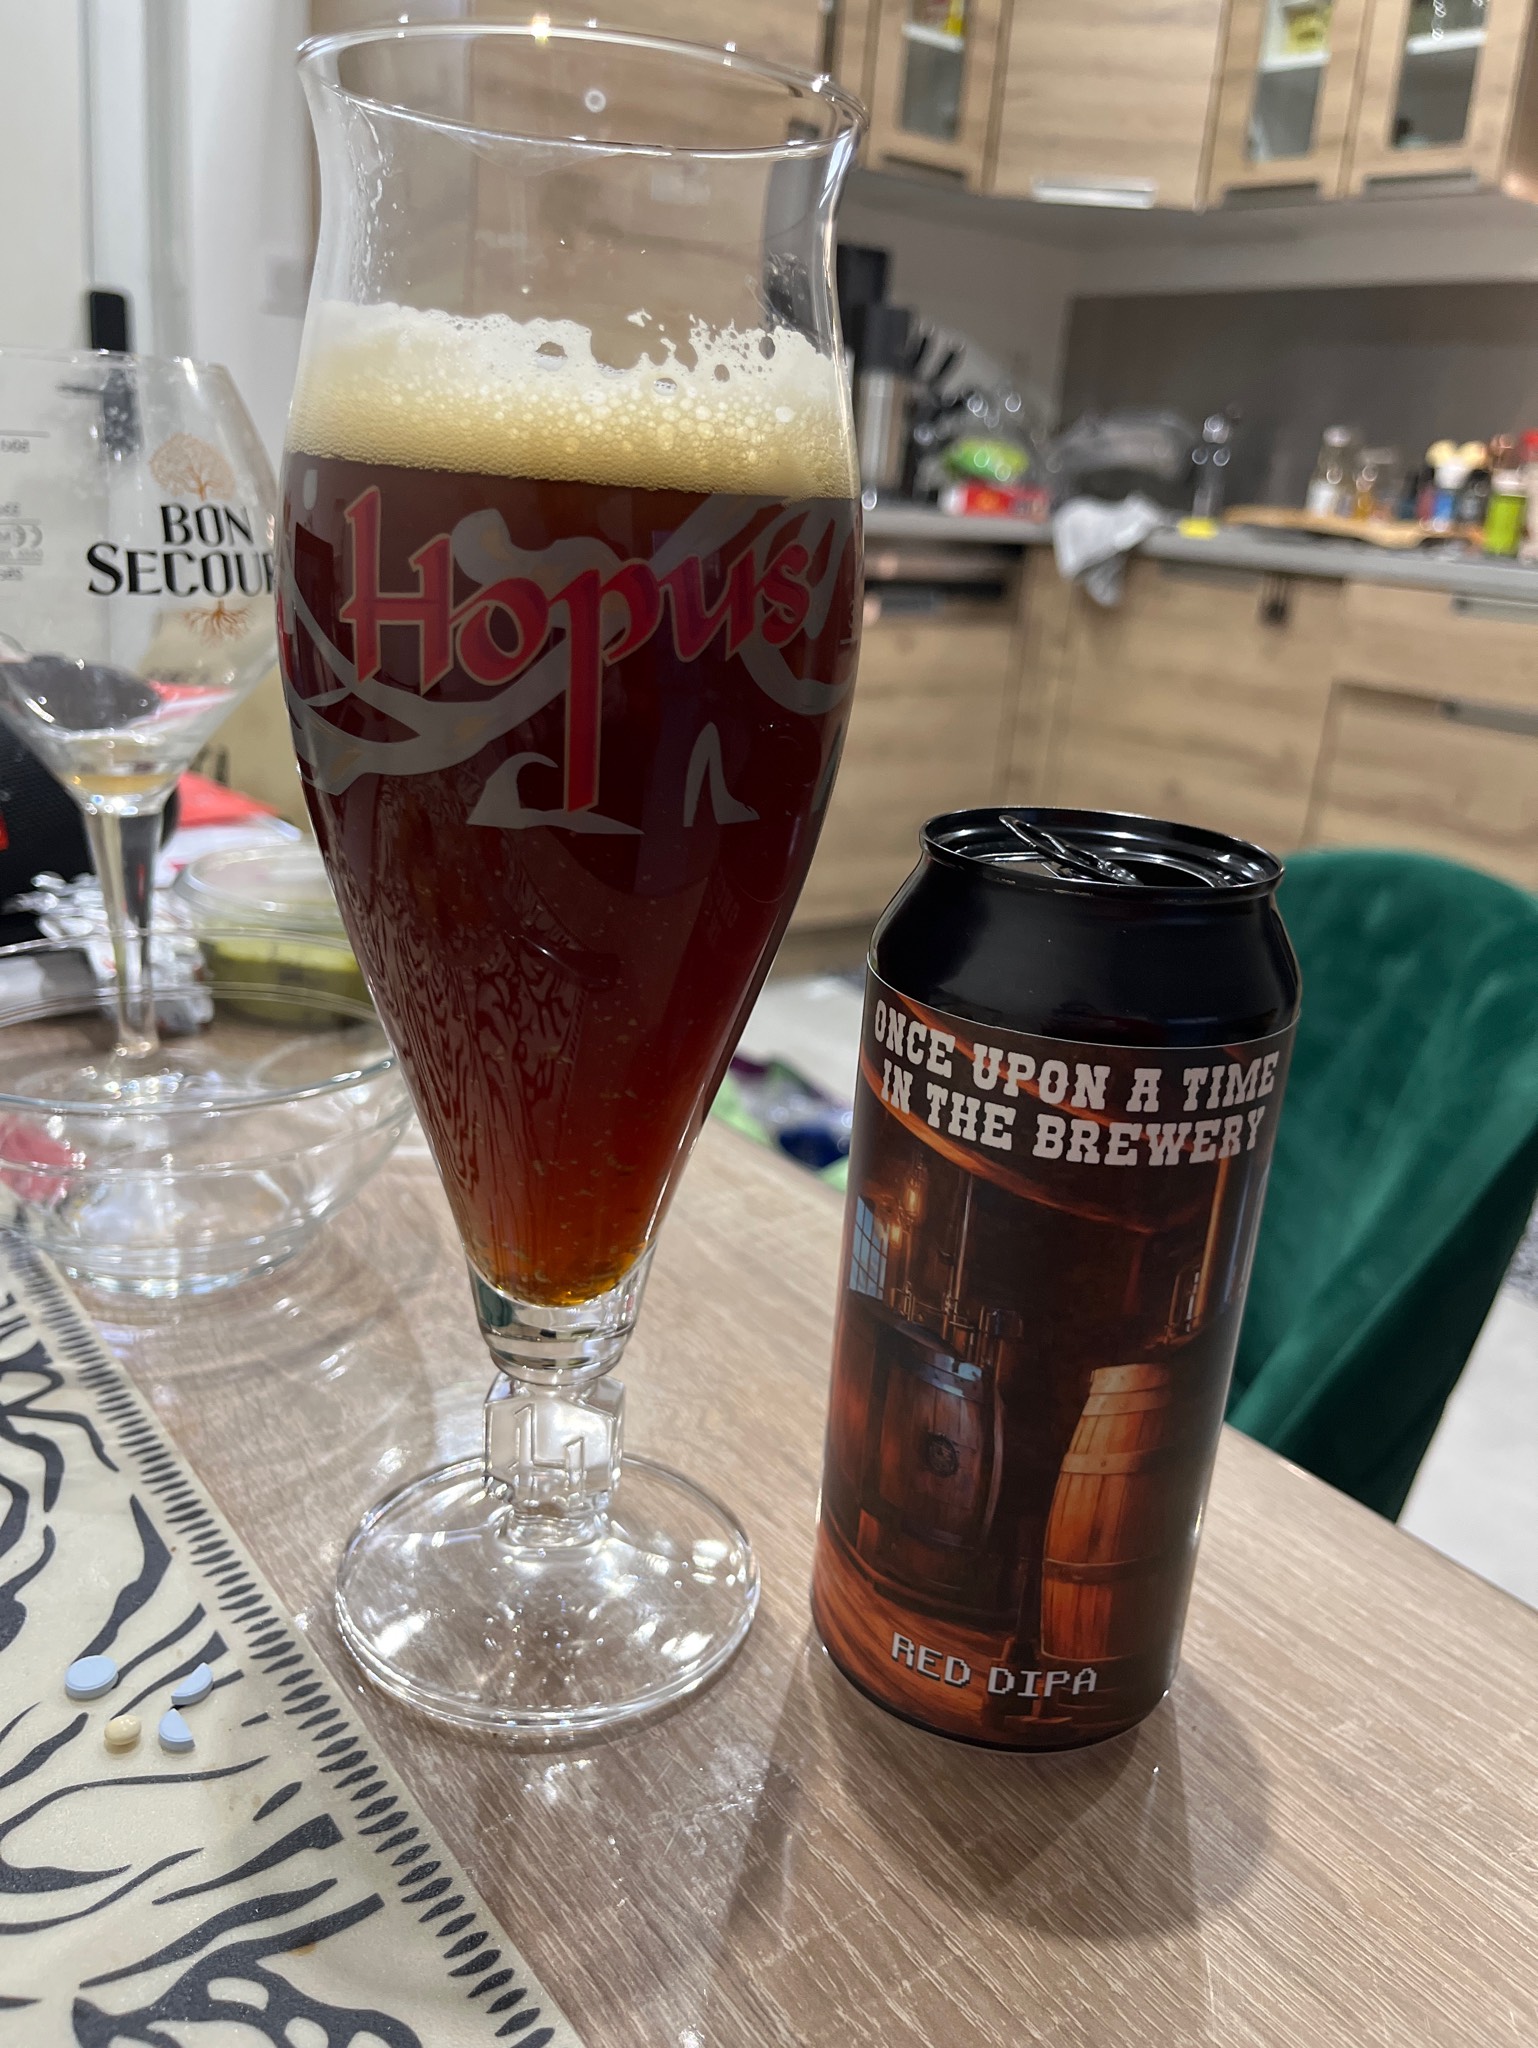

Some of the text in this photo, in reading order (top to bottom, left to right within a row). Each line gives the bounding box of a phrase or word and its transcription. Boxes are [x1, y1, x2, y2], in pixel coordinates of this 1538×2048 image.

[161, 503, 254, 546] BON
[340, 485, 815, 813] Hopus
[874, 1000, 1280, 1112] ONCE UPON A TIME
[880, 1058, 1266, 1167] IN THE BREWERY
[891, 1631, 1098, 1698] RED DIPA
